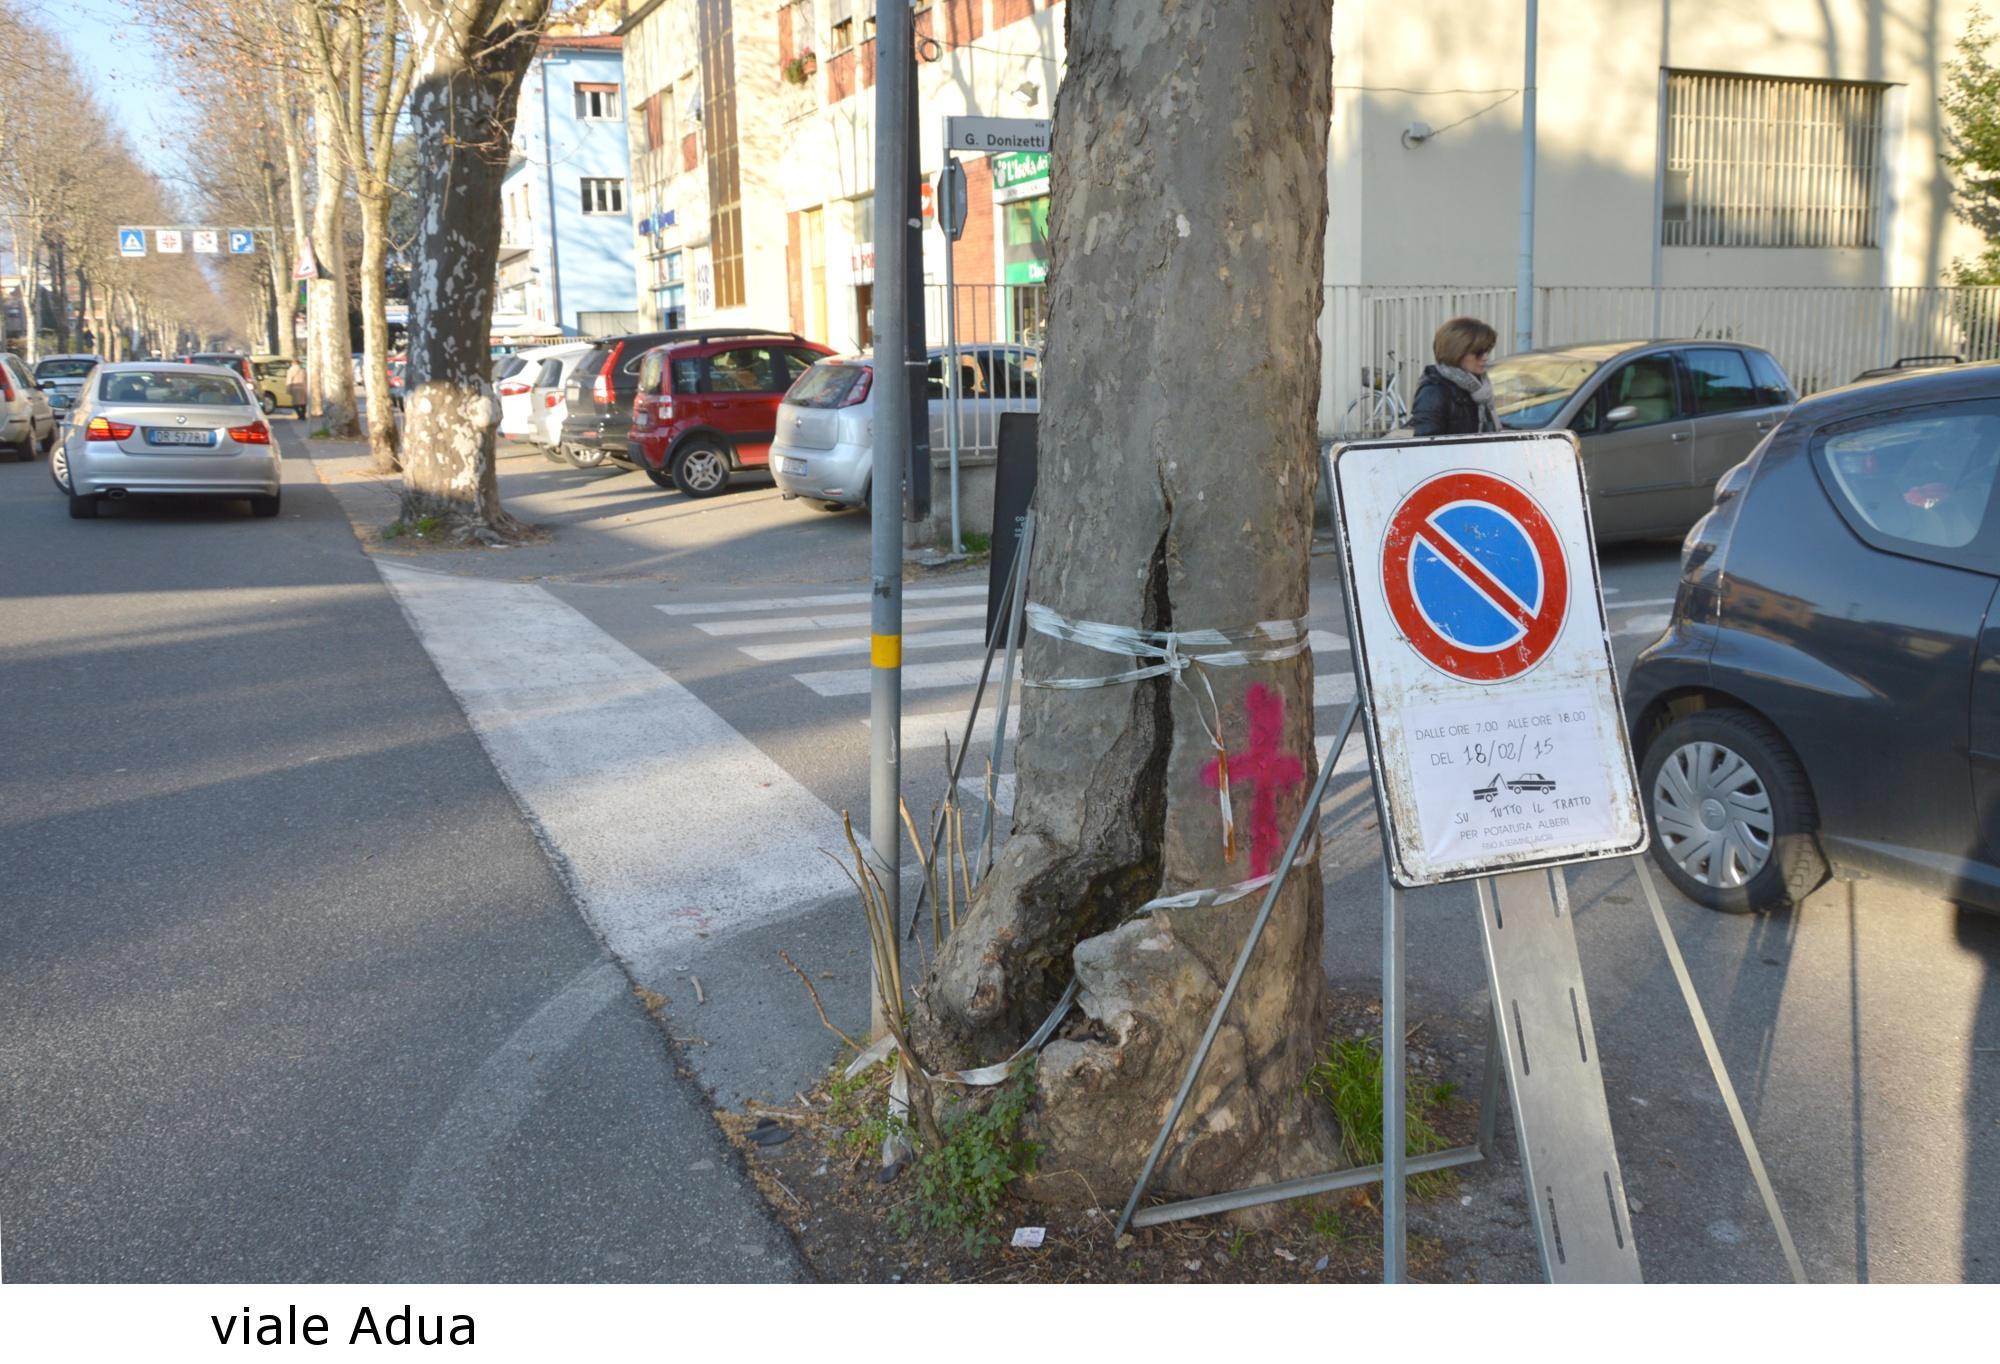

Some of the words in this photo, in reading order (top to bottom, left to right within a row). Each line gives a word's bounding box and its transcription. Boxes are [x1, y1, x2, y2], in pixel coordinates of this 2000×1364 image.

[1034, 121, 1045, 129] via
[965, 132, 979, 146] G.
[987, 134, 1045, 148] Donizetti
[1415, 726, 1446, 741] DALLE
[1448, 724, 1471, 737] ORE
[1507, 717, 1529, 729] ALLE
[1531, 714, 1553, 727] ORE
[1430, 751, 1455, 766] DEL
[1455, 811, 1470, 825] SU
[1490, 803, 1522, 818] TUTTO
[1532, 801, 1545, 814] IL
[1552, 796, 1592, 810] TRATTO
[1460, 829, 1479, 841] PER
[1483, 822, 1533, 837] POTATURA
[1538, 817, 1570, 829] ALBERI
